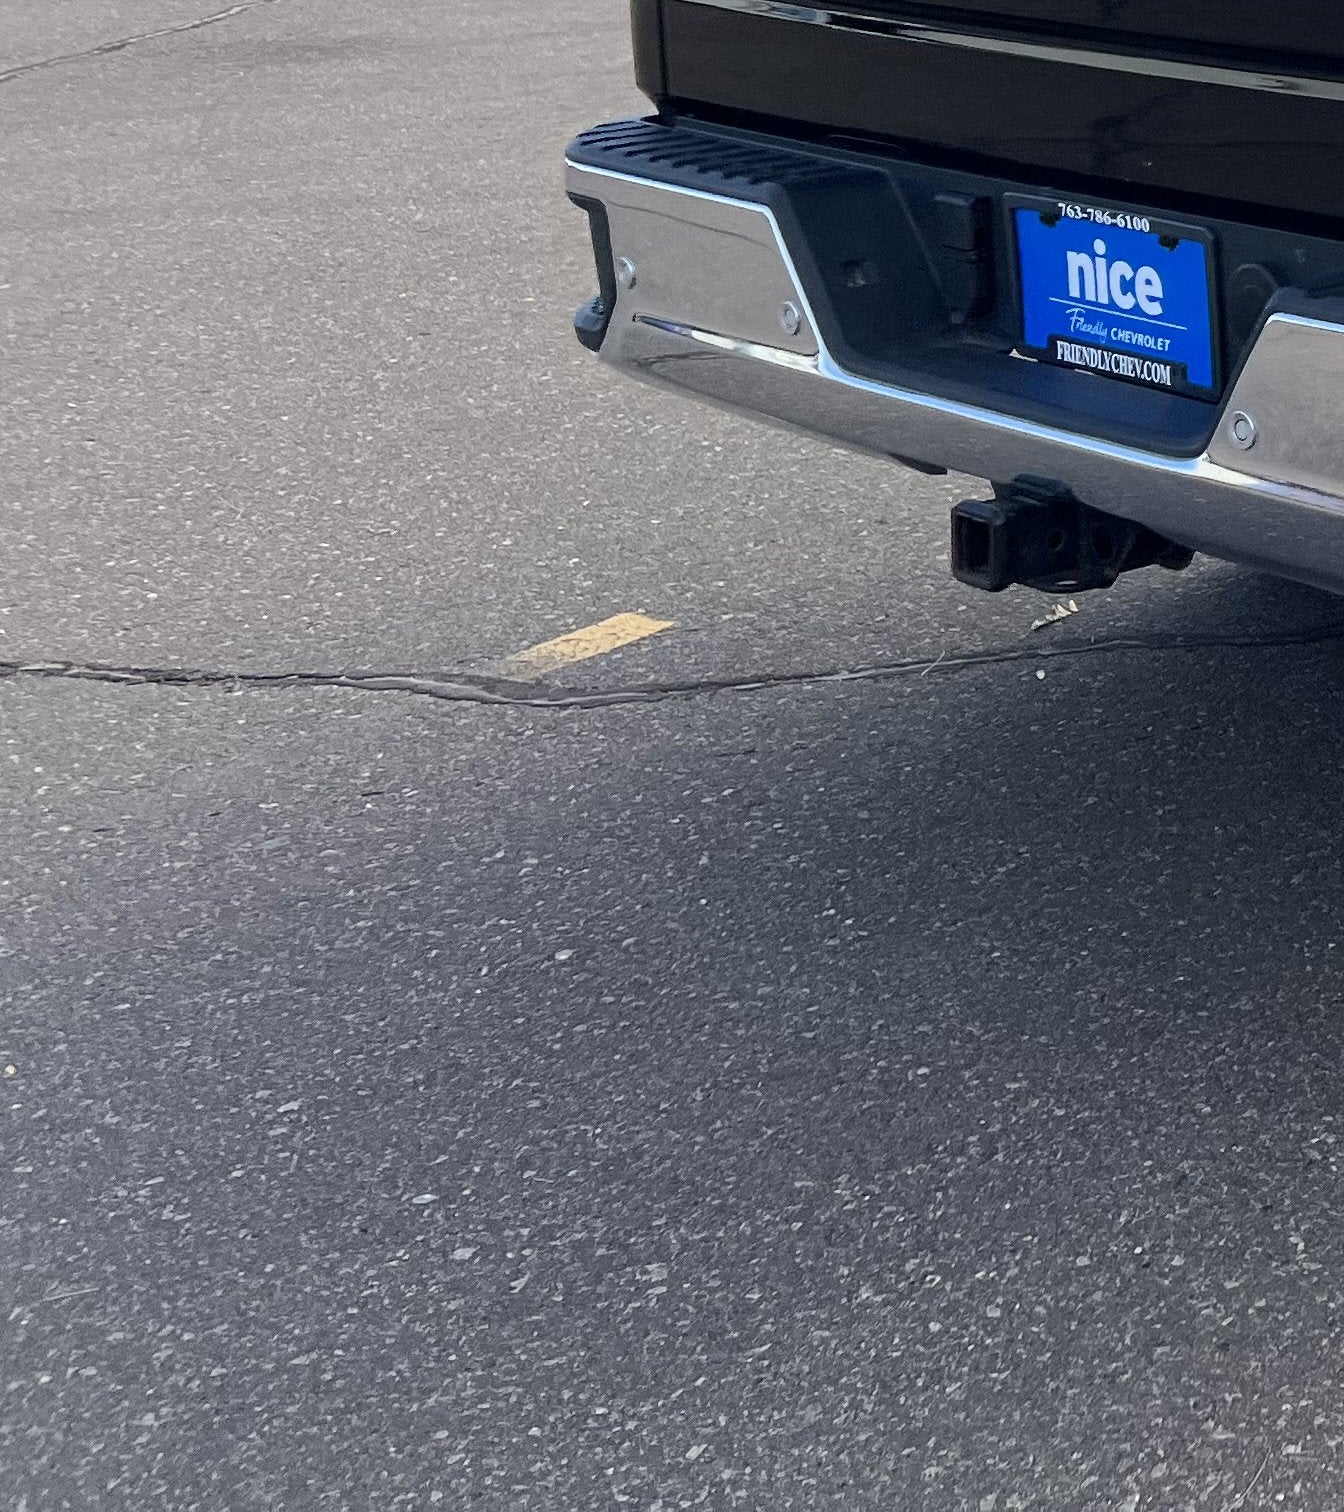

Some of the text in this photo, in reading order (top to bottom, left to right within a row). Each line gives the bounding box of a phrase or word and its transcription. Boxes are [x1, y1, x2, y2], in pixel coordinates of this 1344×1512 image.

[1058, 203, 1150, 233] 763-786-6100
[1066, 238, 1164, 316] nice
[1110, 327, 1171, 352] CHEVROLET
[1056, 340, 1172, 386] FRIENDLYCHEV.COM
